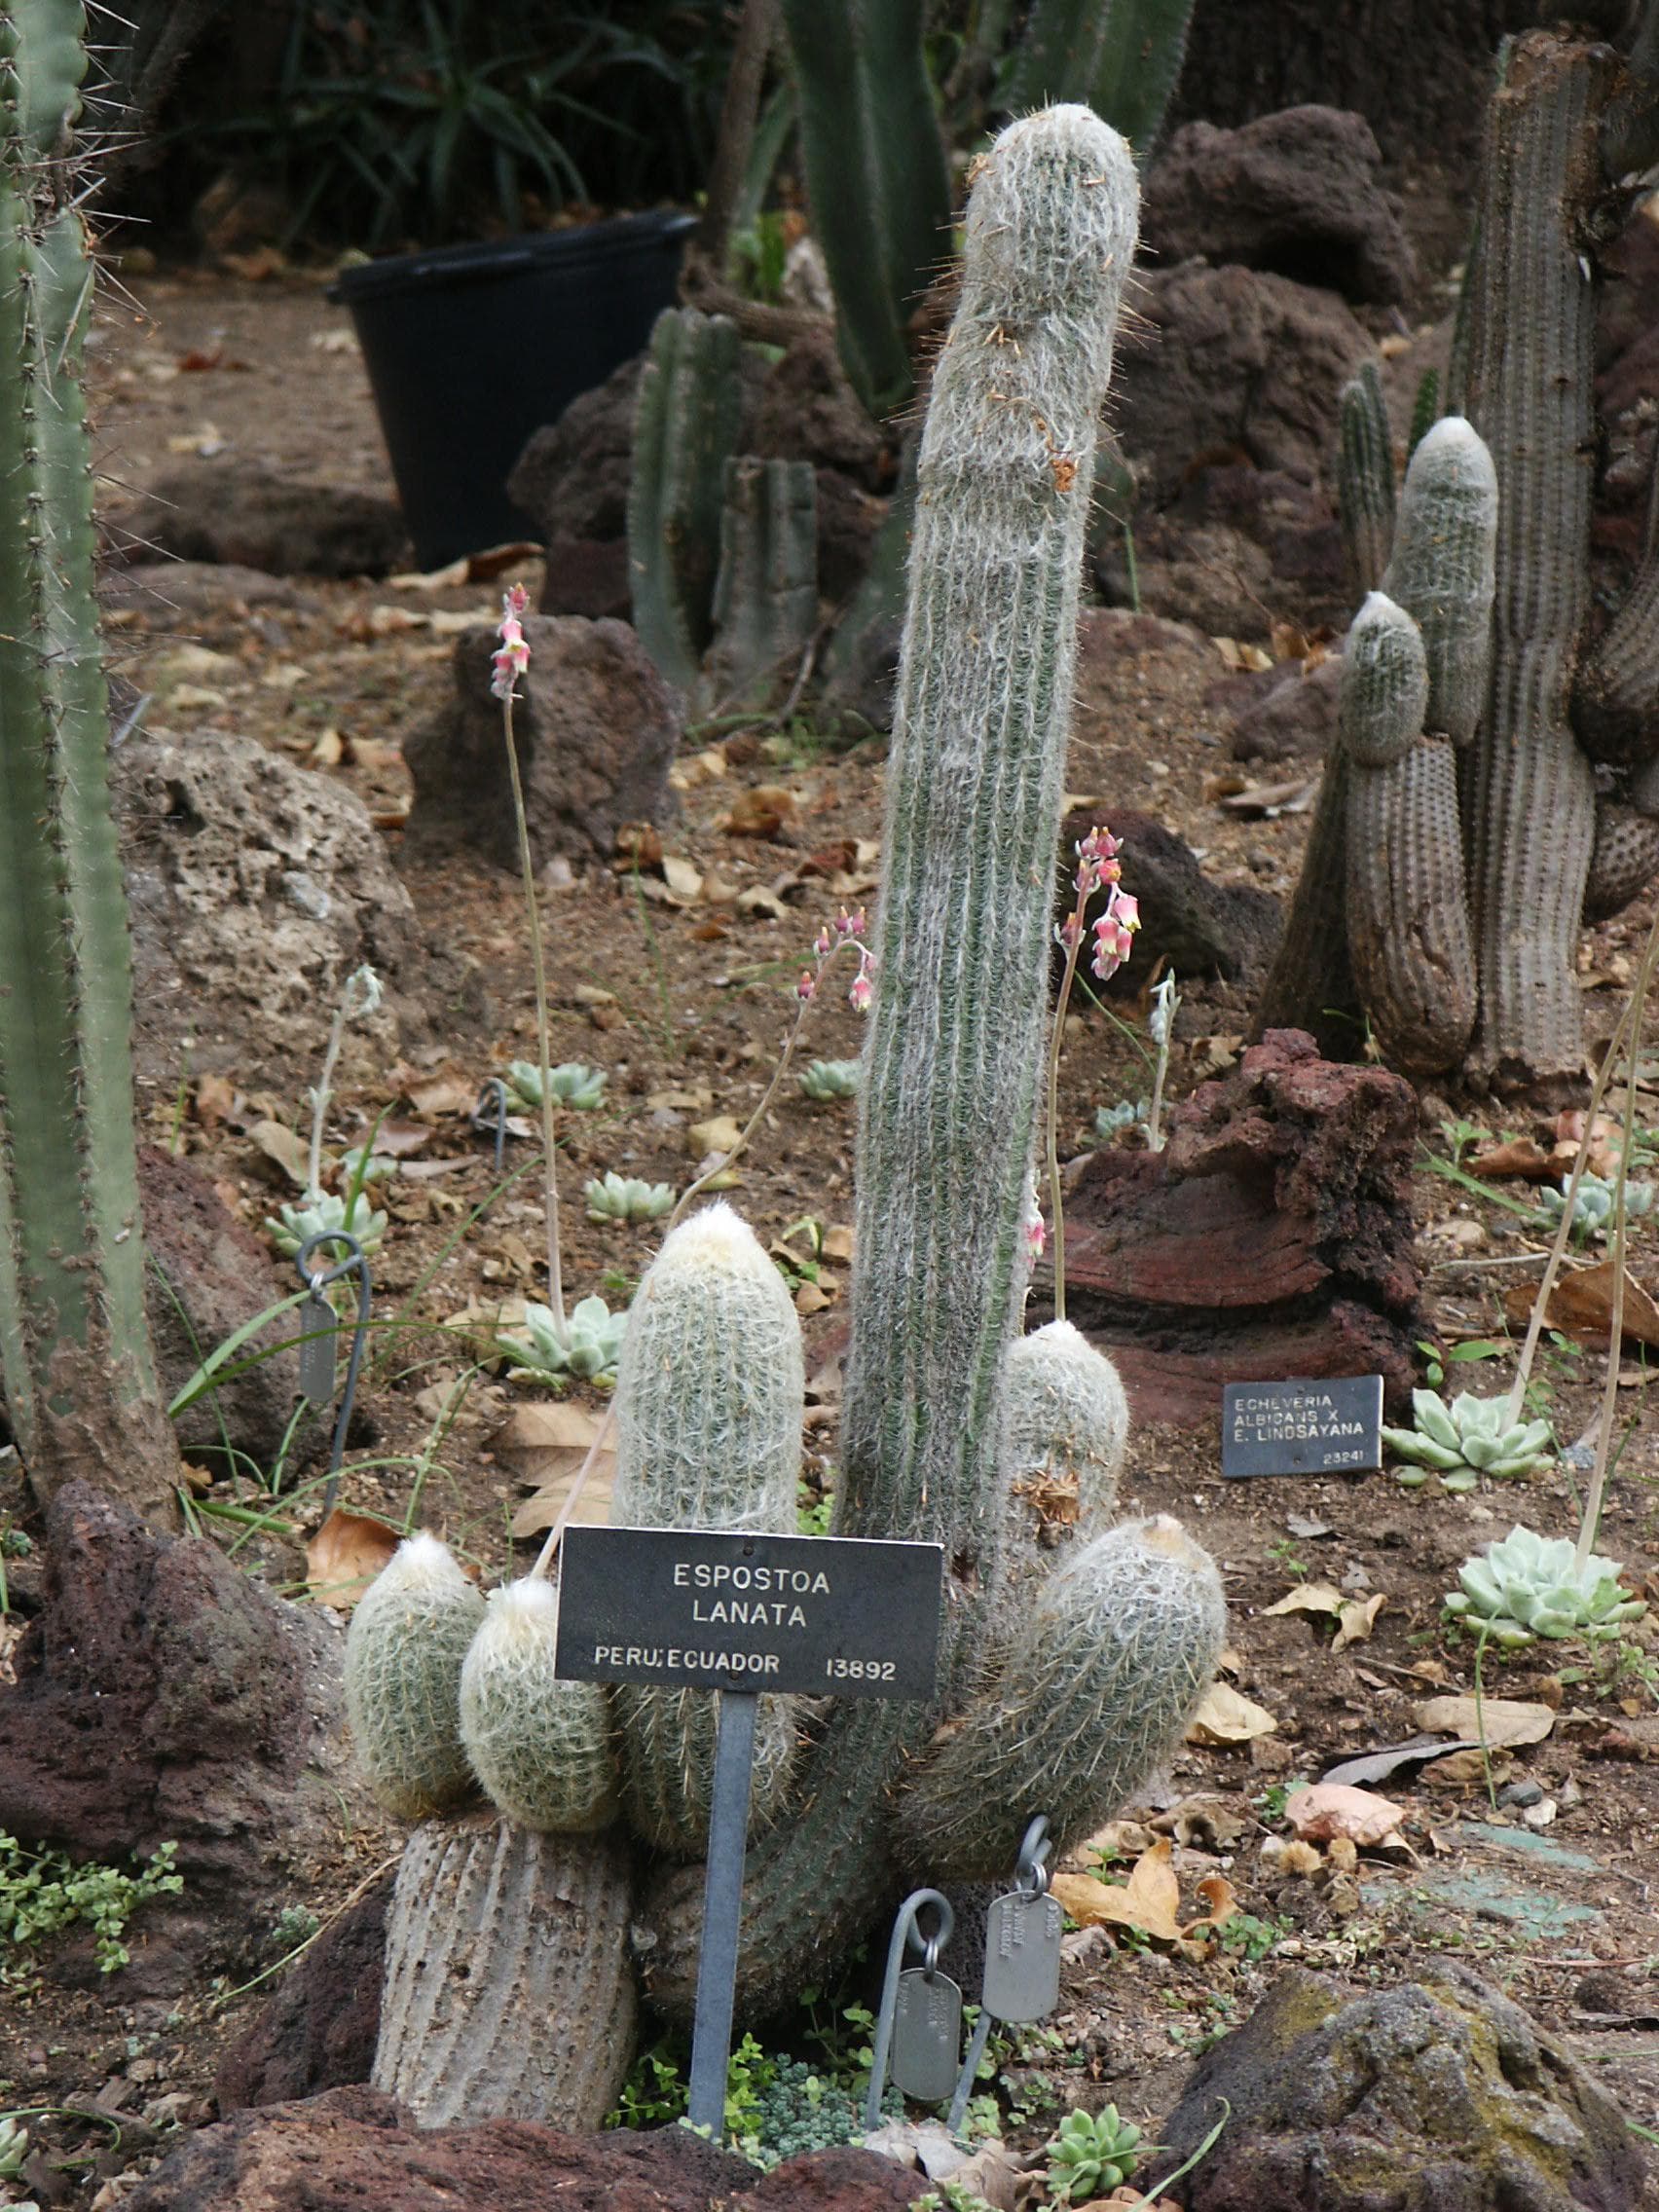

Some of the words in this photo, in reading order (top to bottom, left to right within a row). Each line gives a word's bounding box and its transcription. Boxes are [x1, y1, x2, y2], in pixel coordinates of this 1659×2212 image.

[1235, 1394, 1332, 1412] ECHEVERIA
[1234, 1411, 1318, 1427] ALBICANS
[1328, 1410, 1339, 1421] X
[1234, 1428, 1250, 1443] E.
[1257, 1422, 1364, 1442] LINDSAYANA
[1323, 1451, 1364, 1464] 23241
[674, 1564, 830, 1594] ESPOSTOA
[693, 1600, 807, 1628] LANATA
[826, 1657, 897, 1681] 13892
